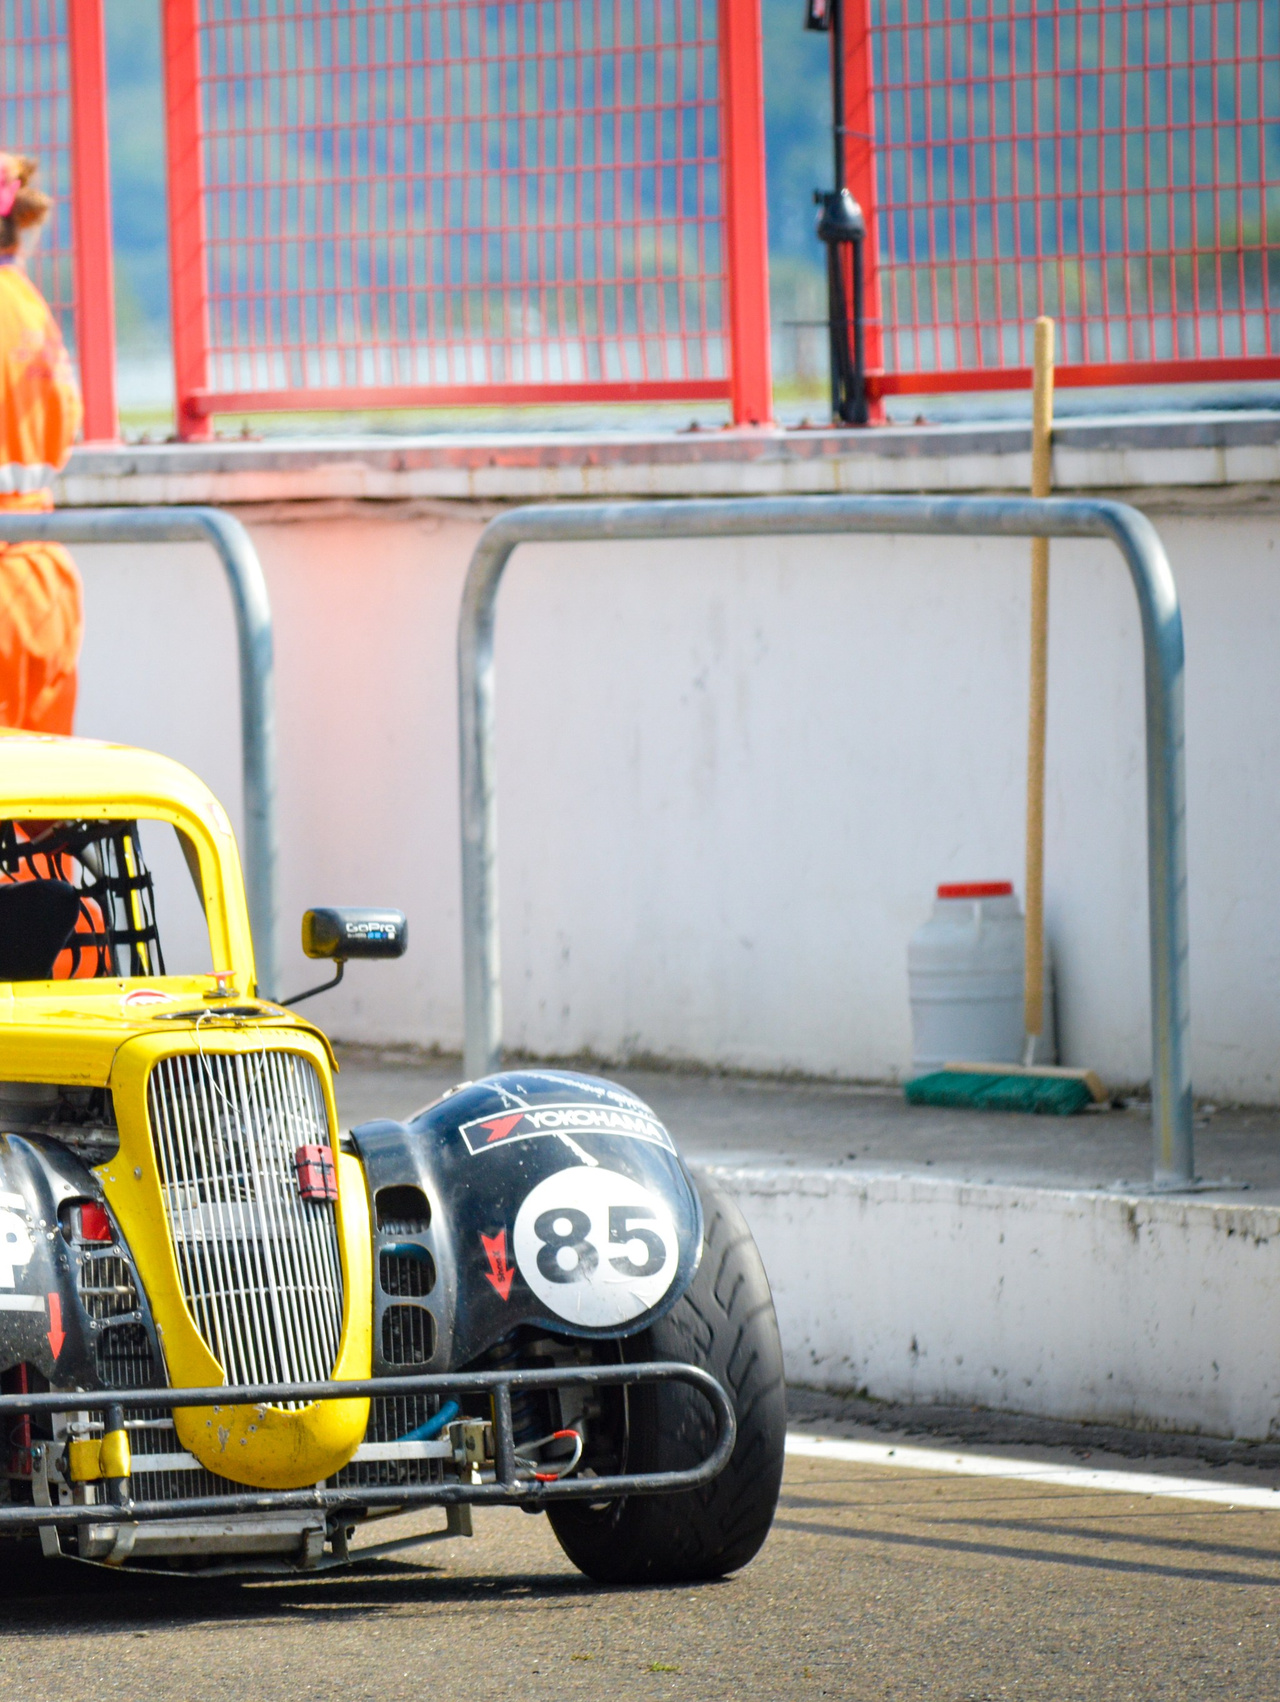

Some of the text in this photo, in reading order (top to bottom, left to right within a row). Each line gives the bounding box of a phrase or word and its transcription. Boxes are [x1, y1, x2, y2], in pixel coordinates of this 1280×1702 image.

[345, 922, 397, 934] GoPro
[524, 1109, 663, 1141] YOKOHAMA
[534, 1205, 667, 1284] 85
